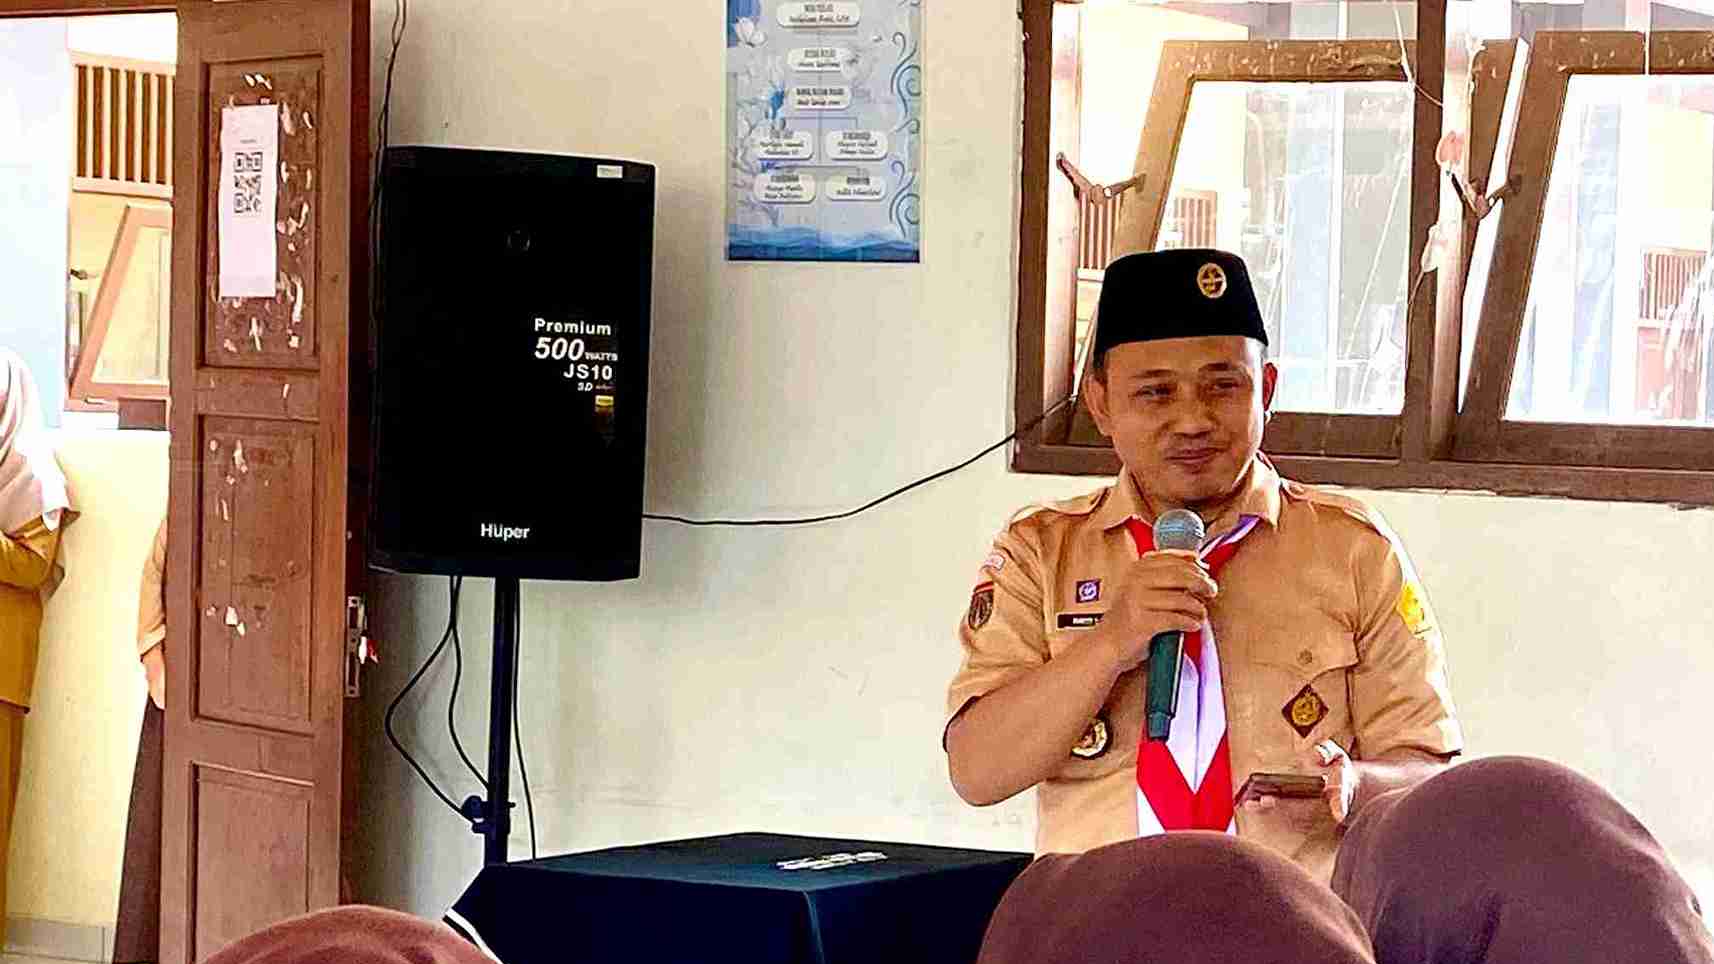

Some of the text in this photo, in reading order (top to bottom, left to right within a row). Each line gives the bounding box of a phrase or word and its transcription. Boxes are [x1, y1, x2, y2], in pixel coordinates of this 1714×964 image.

[534, 317, 612, 336] Premium
[534, 336, 585, 361] 500
[562, 362, 613, 380] JS10
